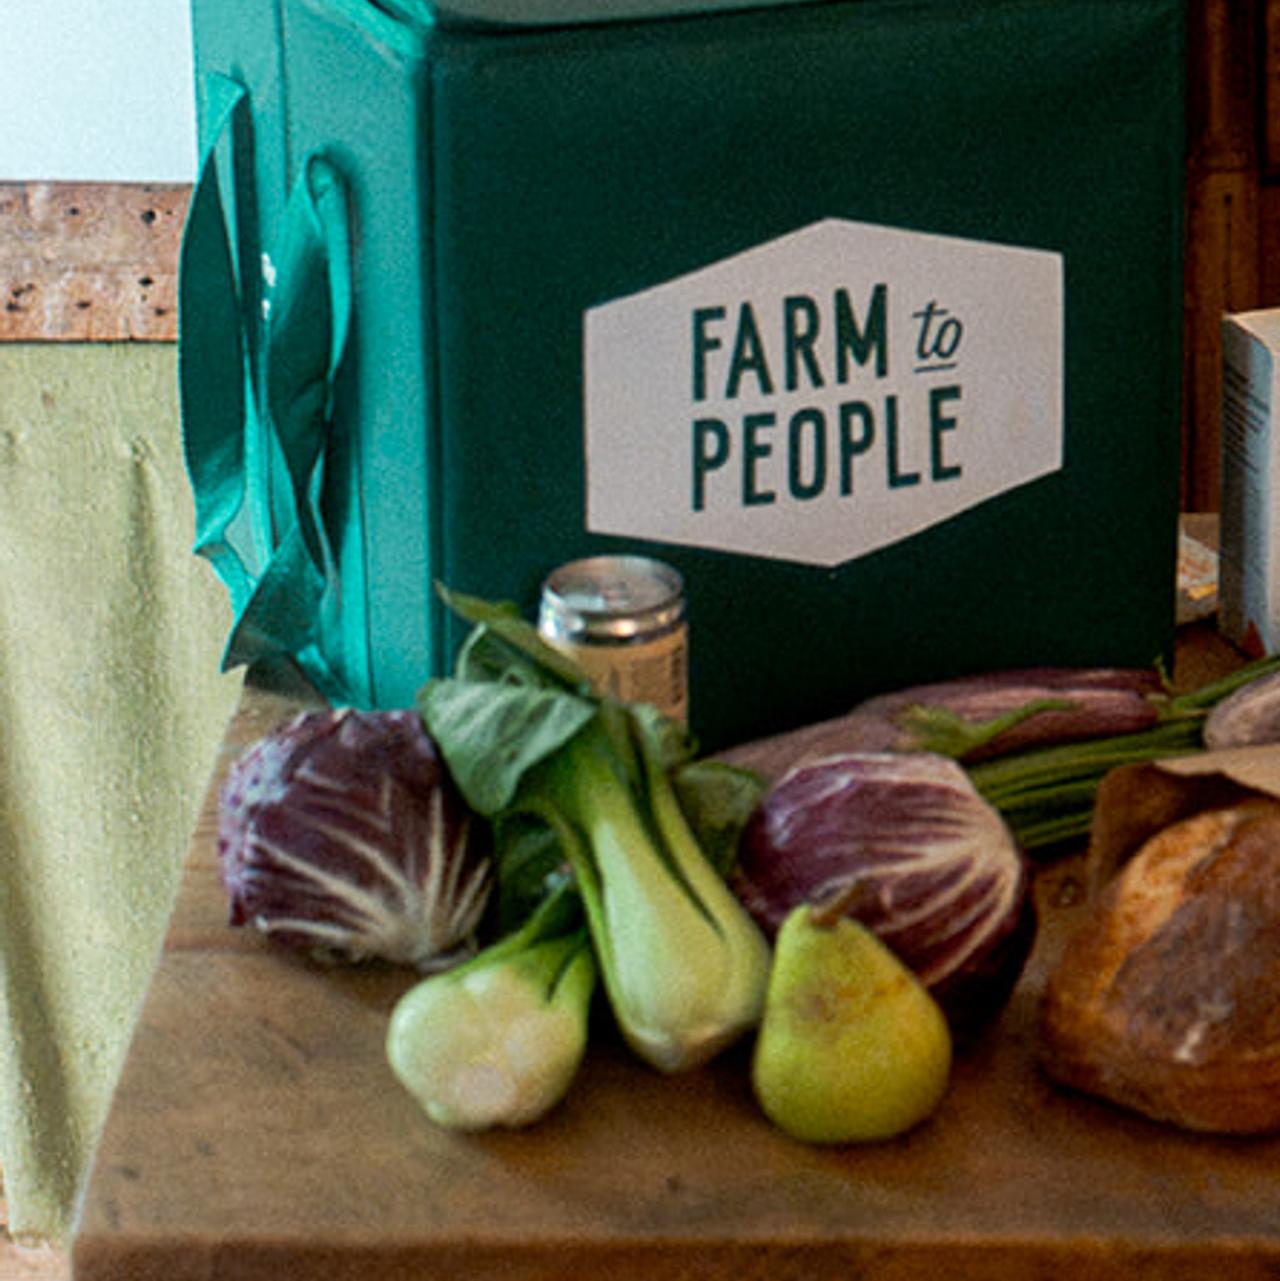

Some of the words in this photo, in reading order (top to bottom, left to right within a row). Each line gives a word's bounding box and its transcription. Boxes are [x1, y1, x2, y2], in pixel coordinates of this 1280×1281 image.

[691, 283, 888, 403] FARM
[911, 300, 963, 368] to
[691, 384, 962, 513] PEOPLE
